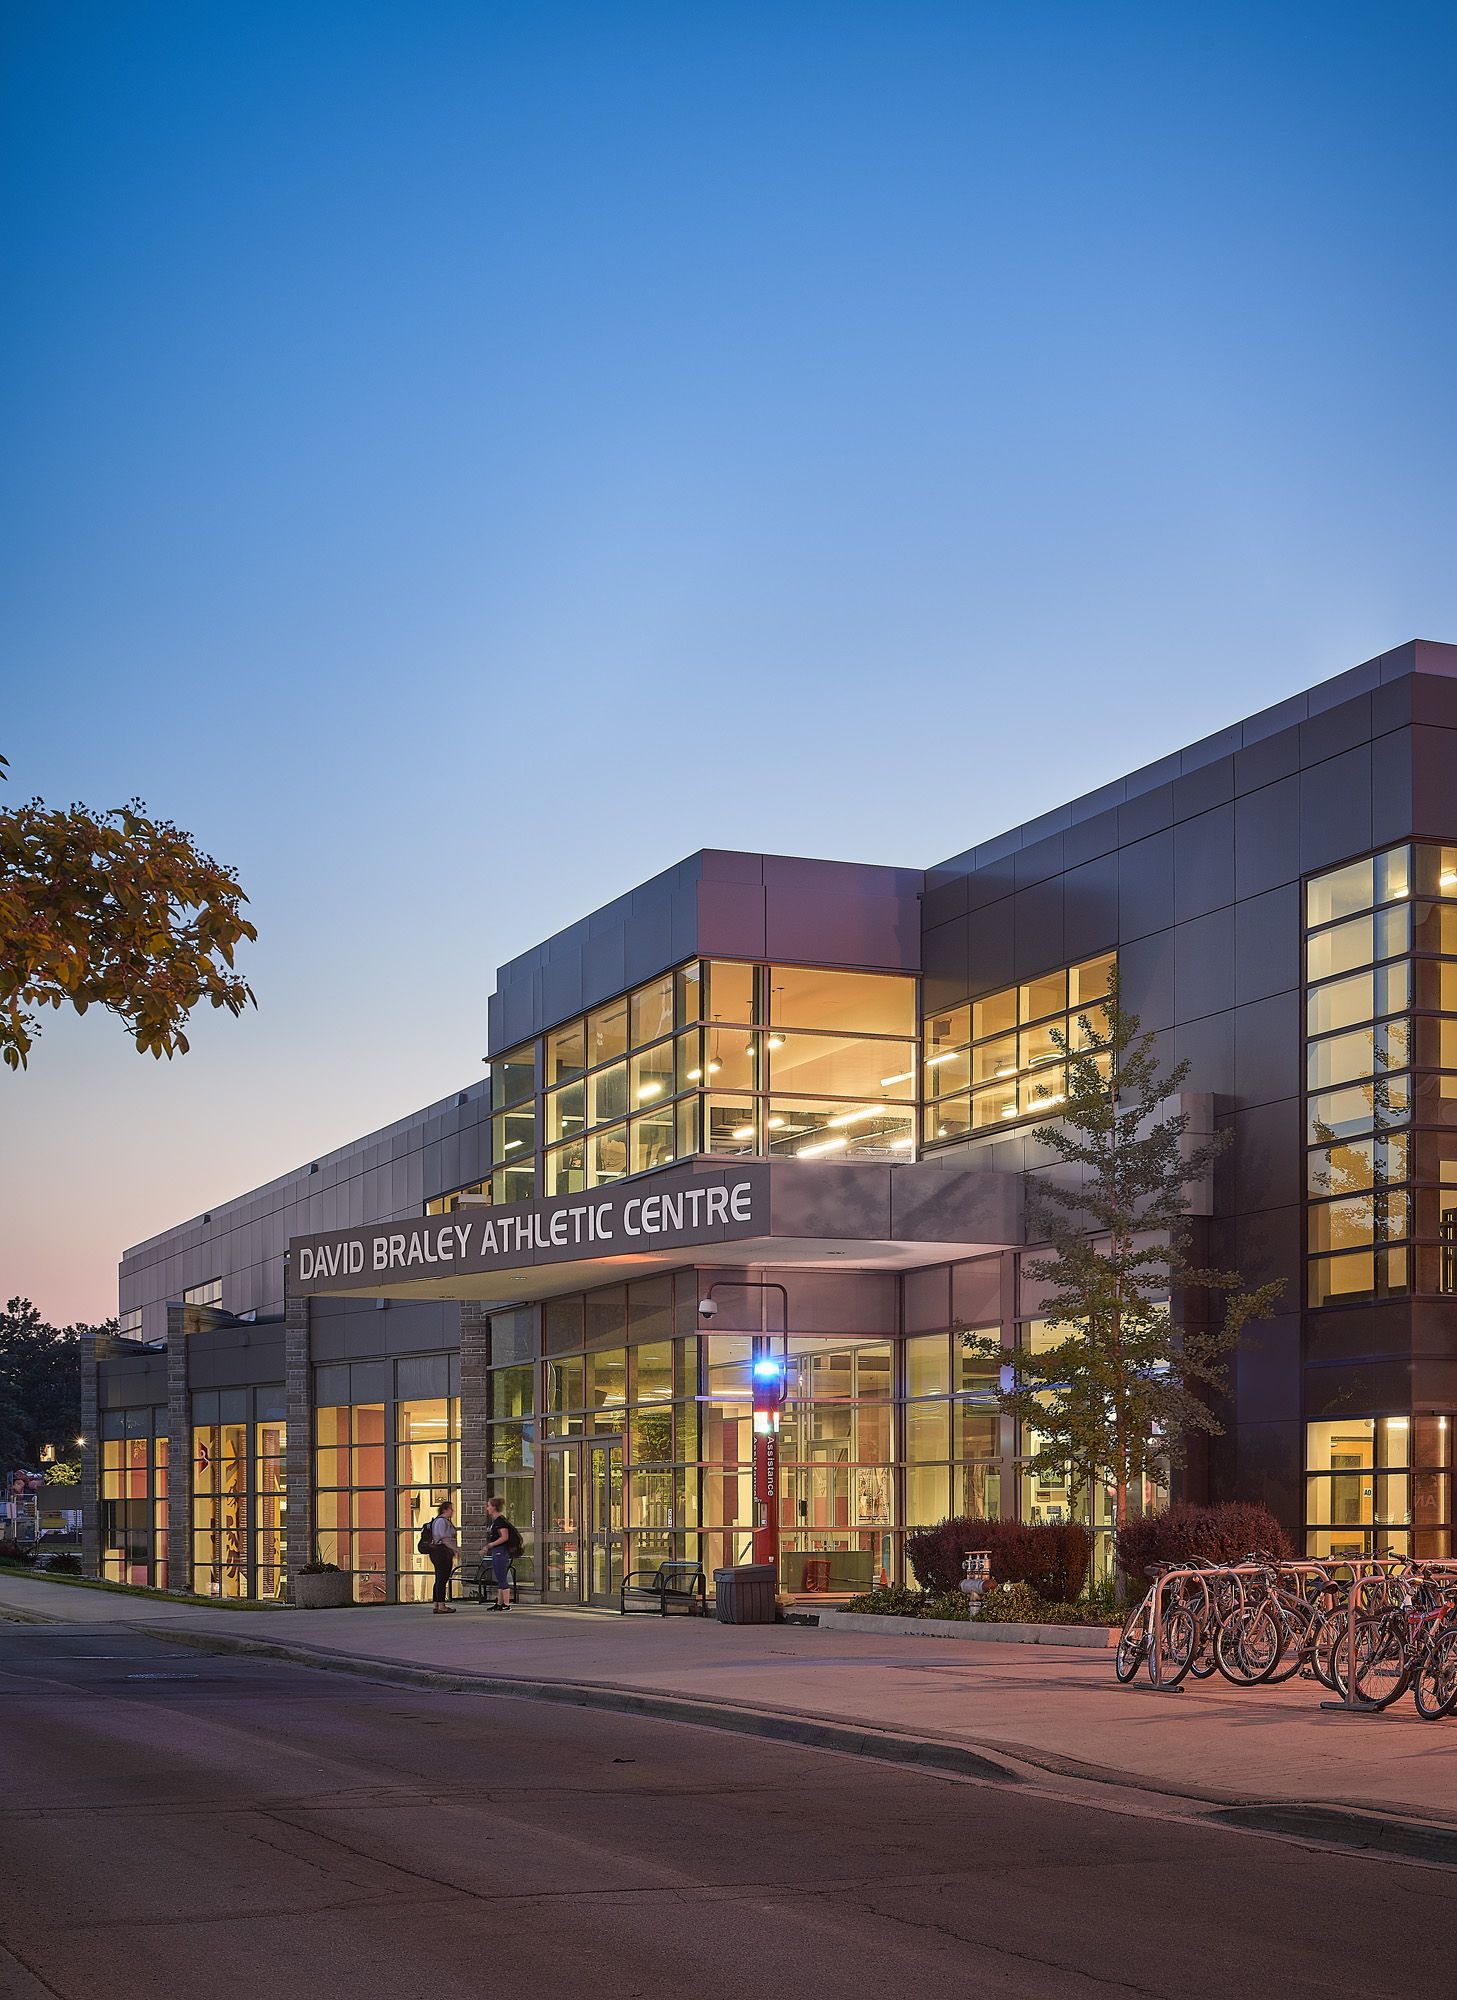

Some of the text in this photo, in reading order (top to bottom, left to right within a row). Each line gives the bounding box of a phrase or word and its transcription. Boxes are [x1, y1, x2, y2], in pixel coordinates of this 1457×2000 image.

[300, 1182, 752, 1281] DAVID BRALEY ATHLETIC CENTRE
[767, 1436, 775, 1497] Assistance
